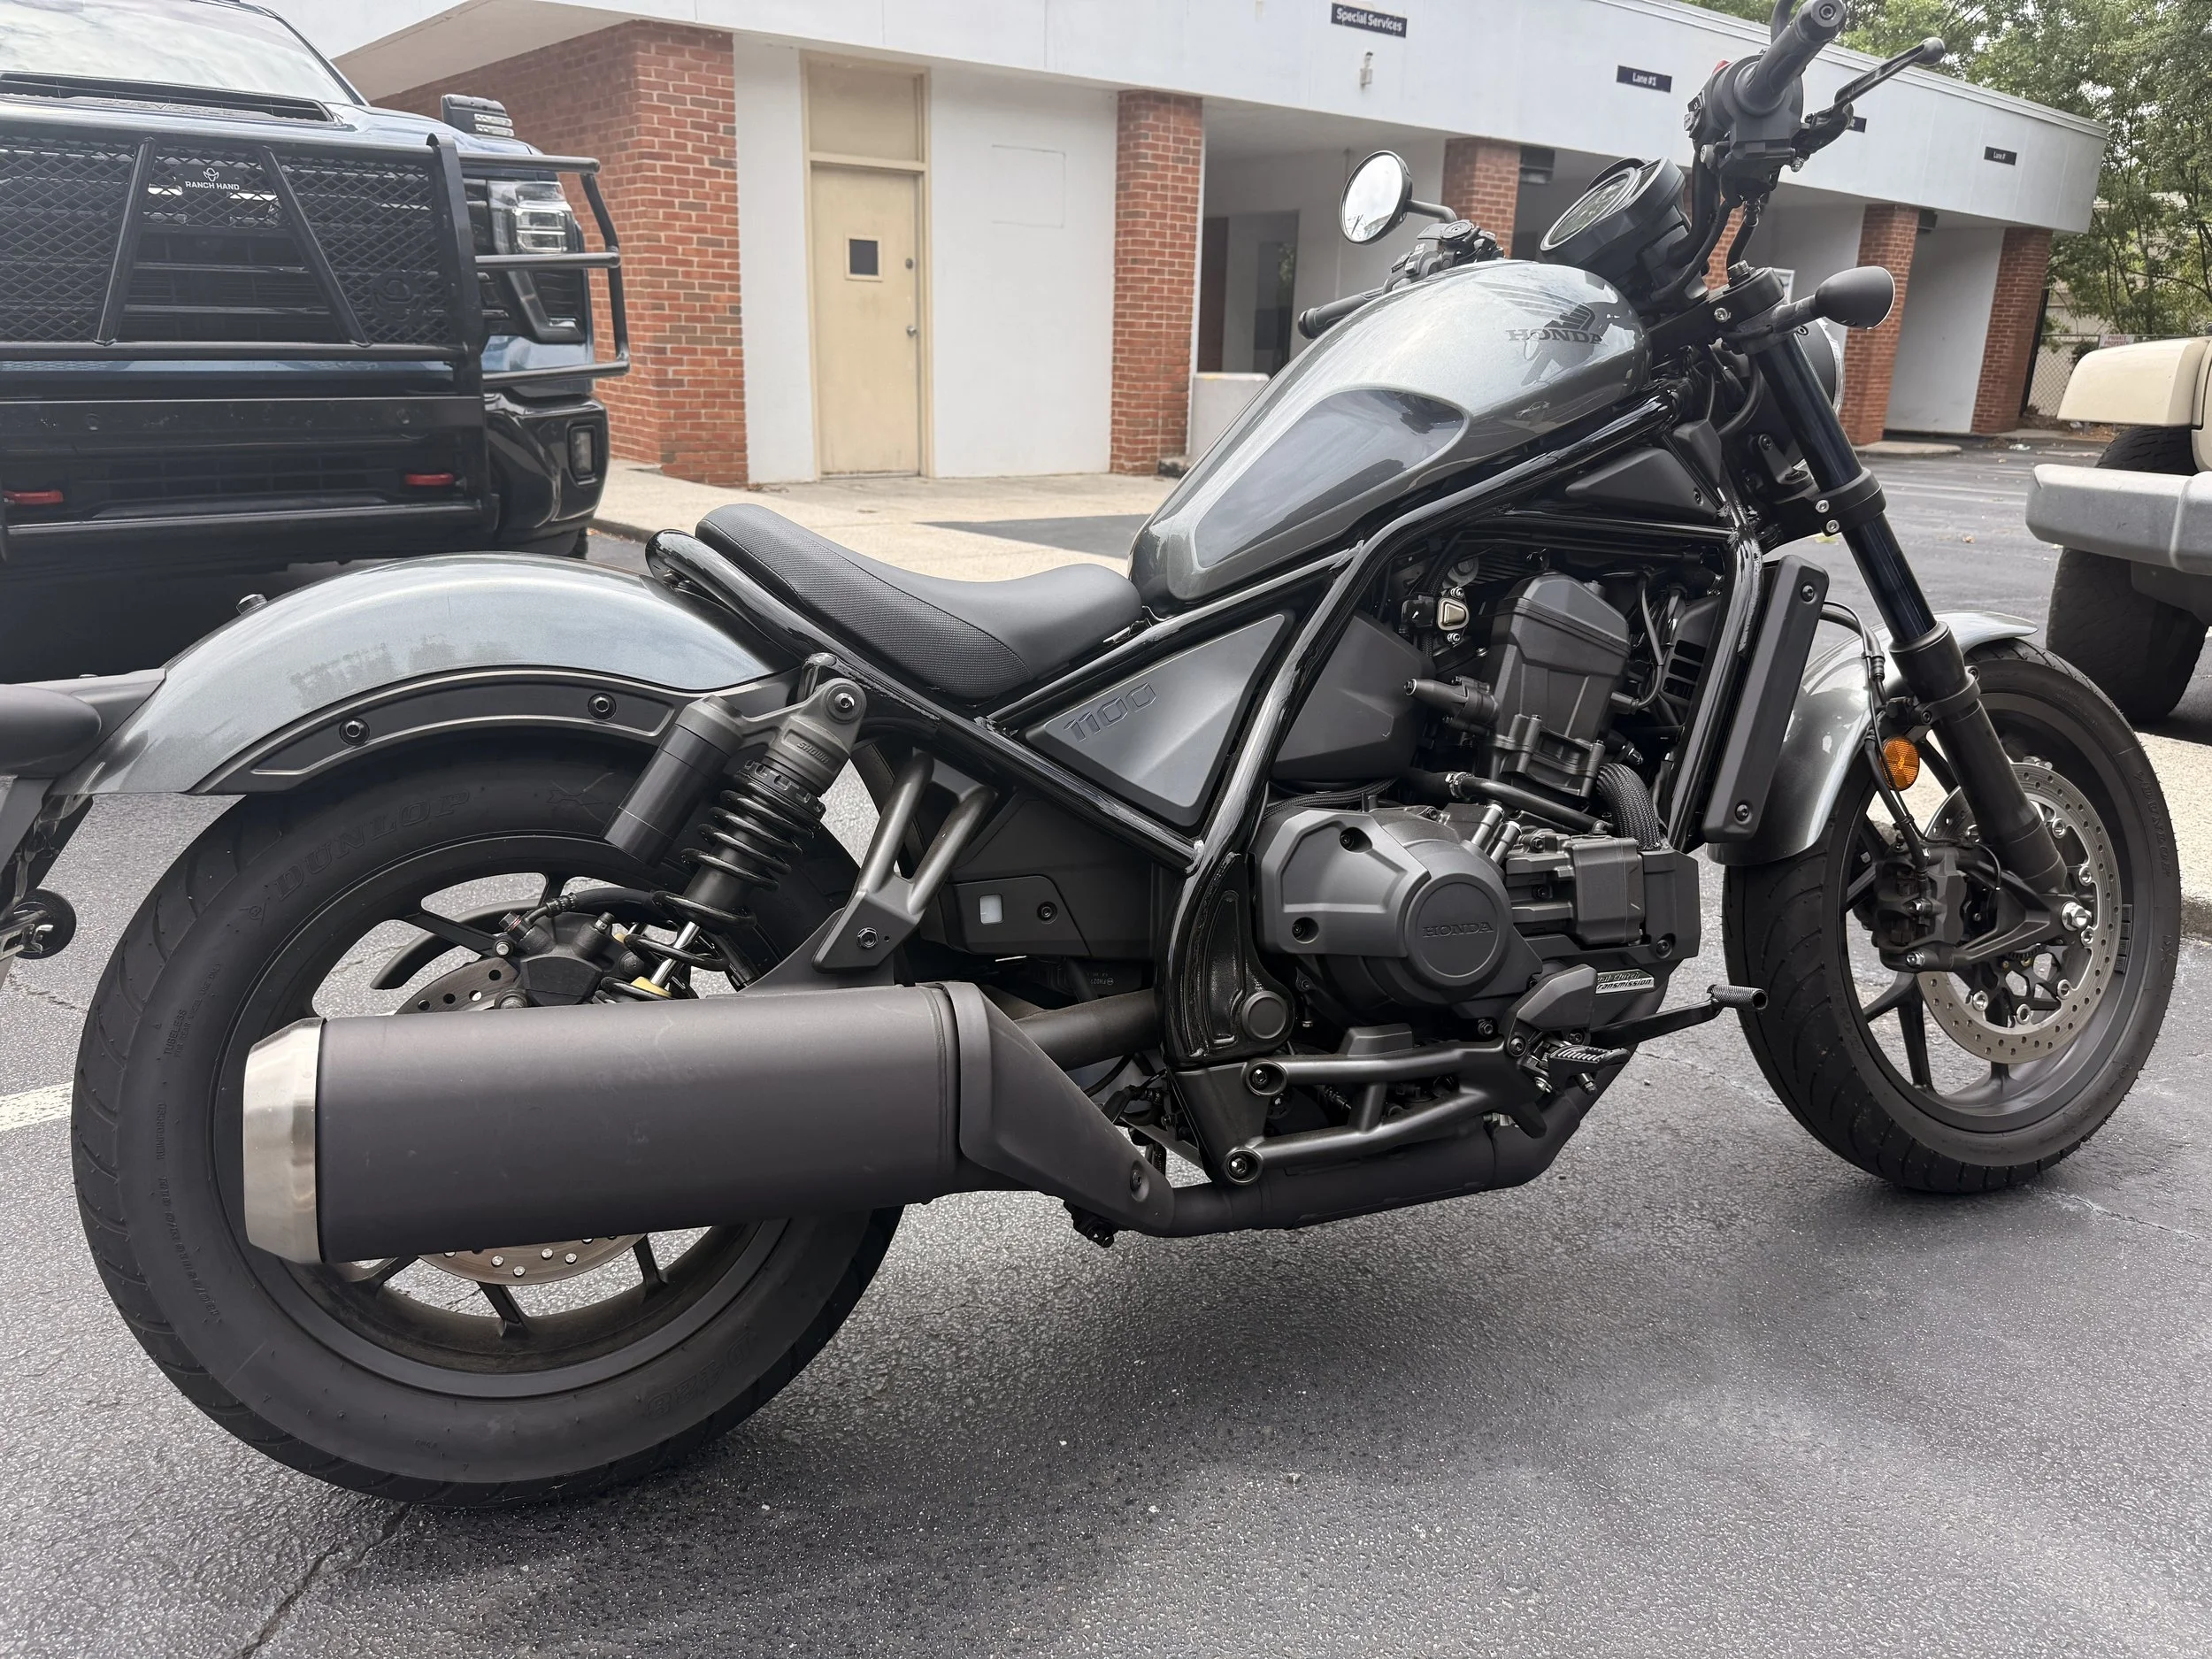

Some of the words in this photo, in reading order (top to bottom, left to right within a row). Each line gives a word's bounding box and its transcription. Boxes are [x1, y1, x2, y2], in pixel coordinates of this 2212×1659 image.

[1336, 8, 1367, 25] Special
[1368, 14, 1403, 32] Services
[184, 180, 215, 189] RANCH
[216, 182, 240, 191] HAND
[1505, 328, 1609, 345] HONDA
[1064, 682, 1156, 742] 1100
[796, 741, 829, 764] SHOWA
[273, 789, 470, 901] DUNLOP
[1422, 922, 1494, 938] HONDA
[1597, 979, 1652, 989] ransmission
[1613, 972, 1640, 981] Clutch
